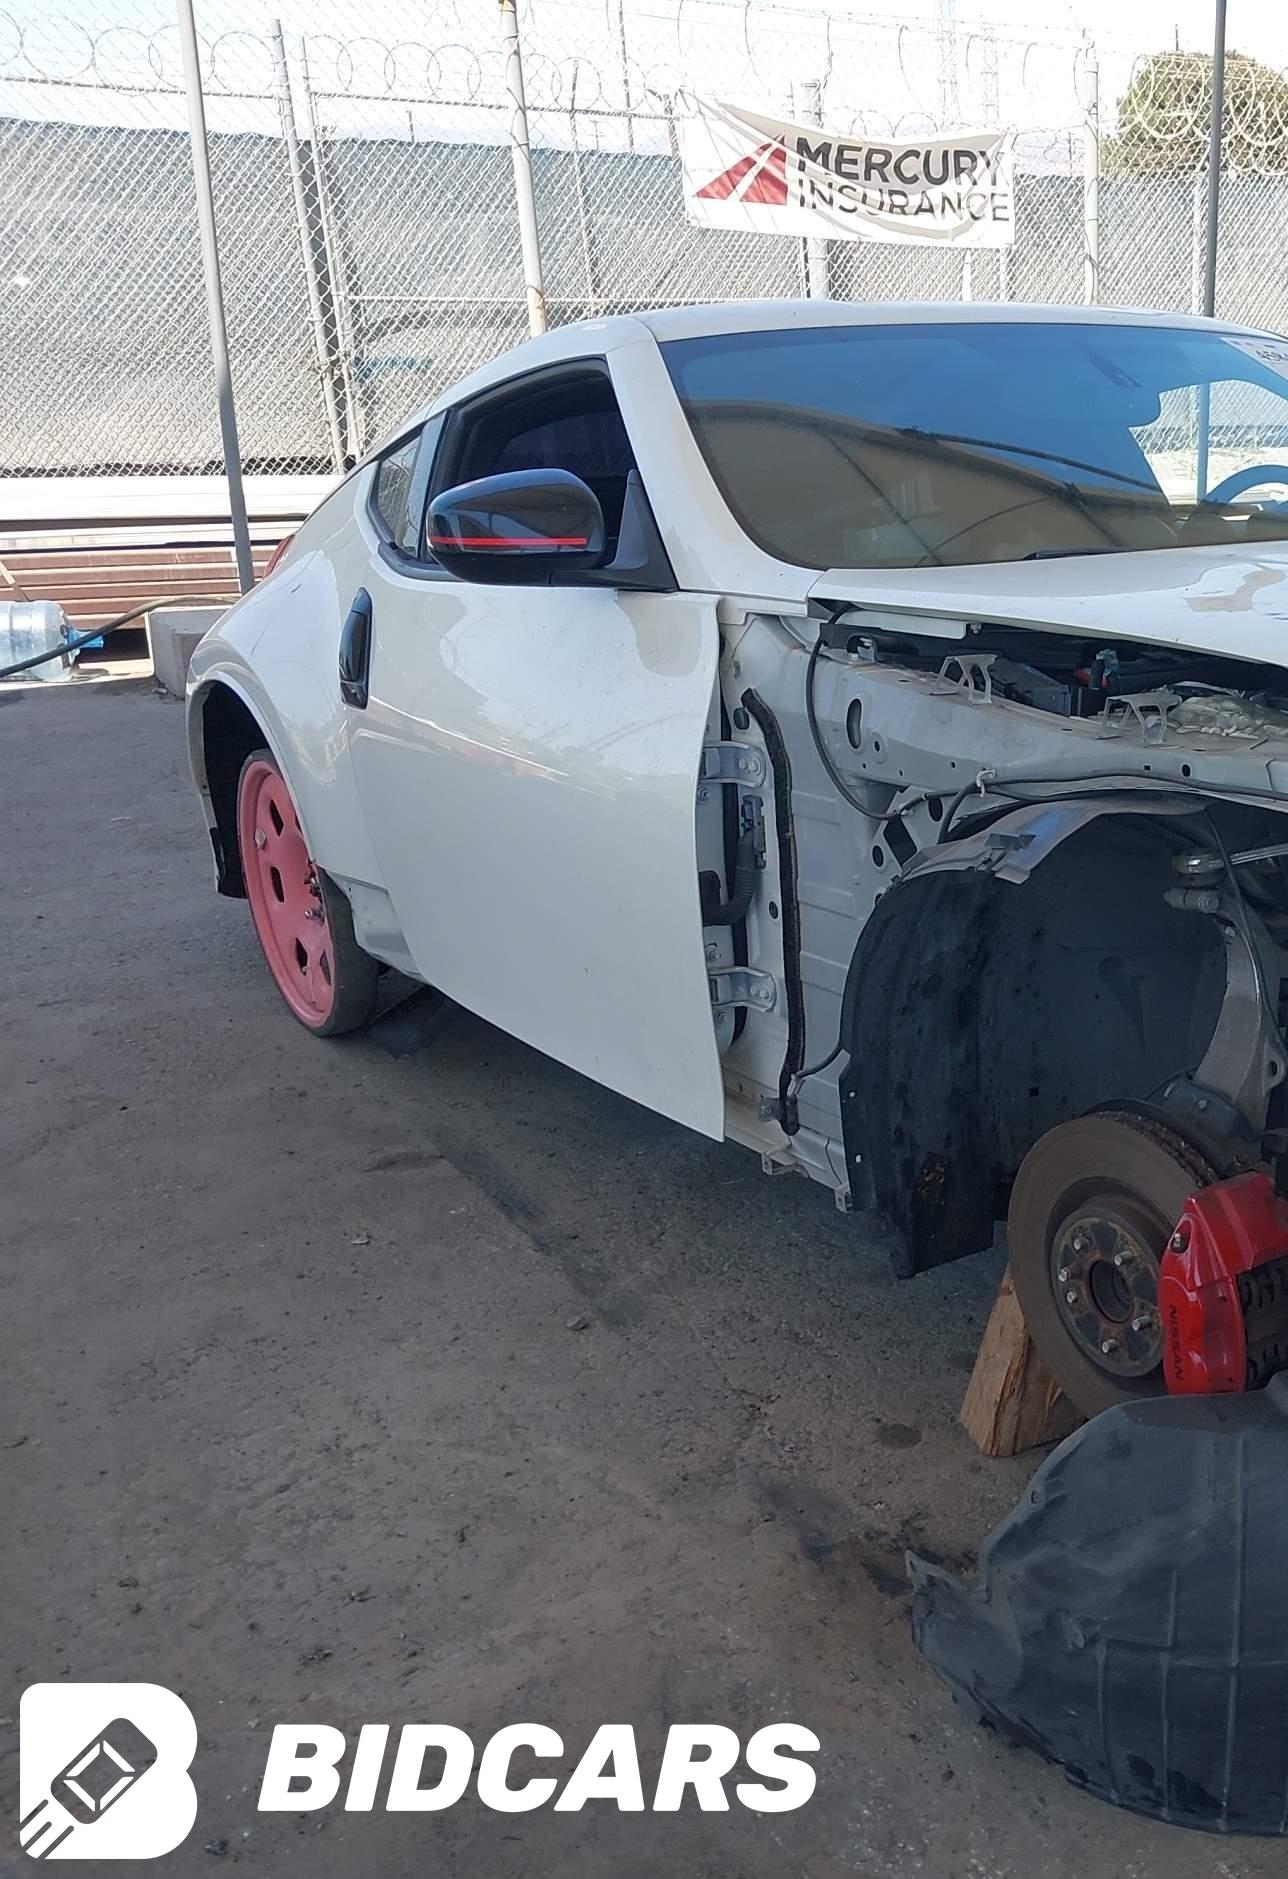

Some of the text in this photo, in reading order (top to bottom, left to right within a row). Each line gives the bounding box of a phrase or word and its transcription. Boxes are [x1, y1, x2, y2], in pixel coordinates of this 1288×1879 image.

[796, 136, 1005, 187] MERCURY
[799, 178, 1010, 222] INSURANCE
[1168, 1304, 1183, 1381] NISSAN
